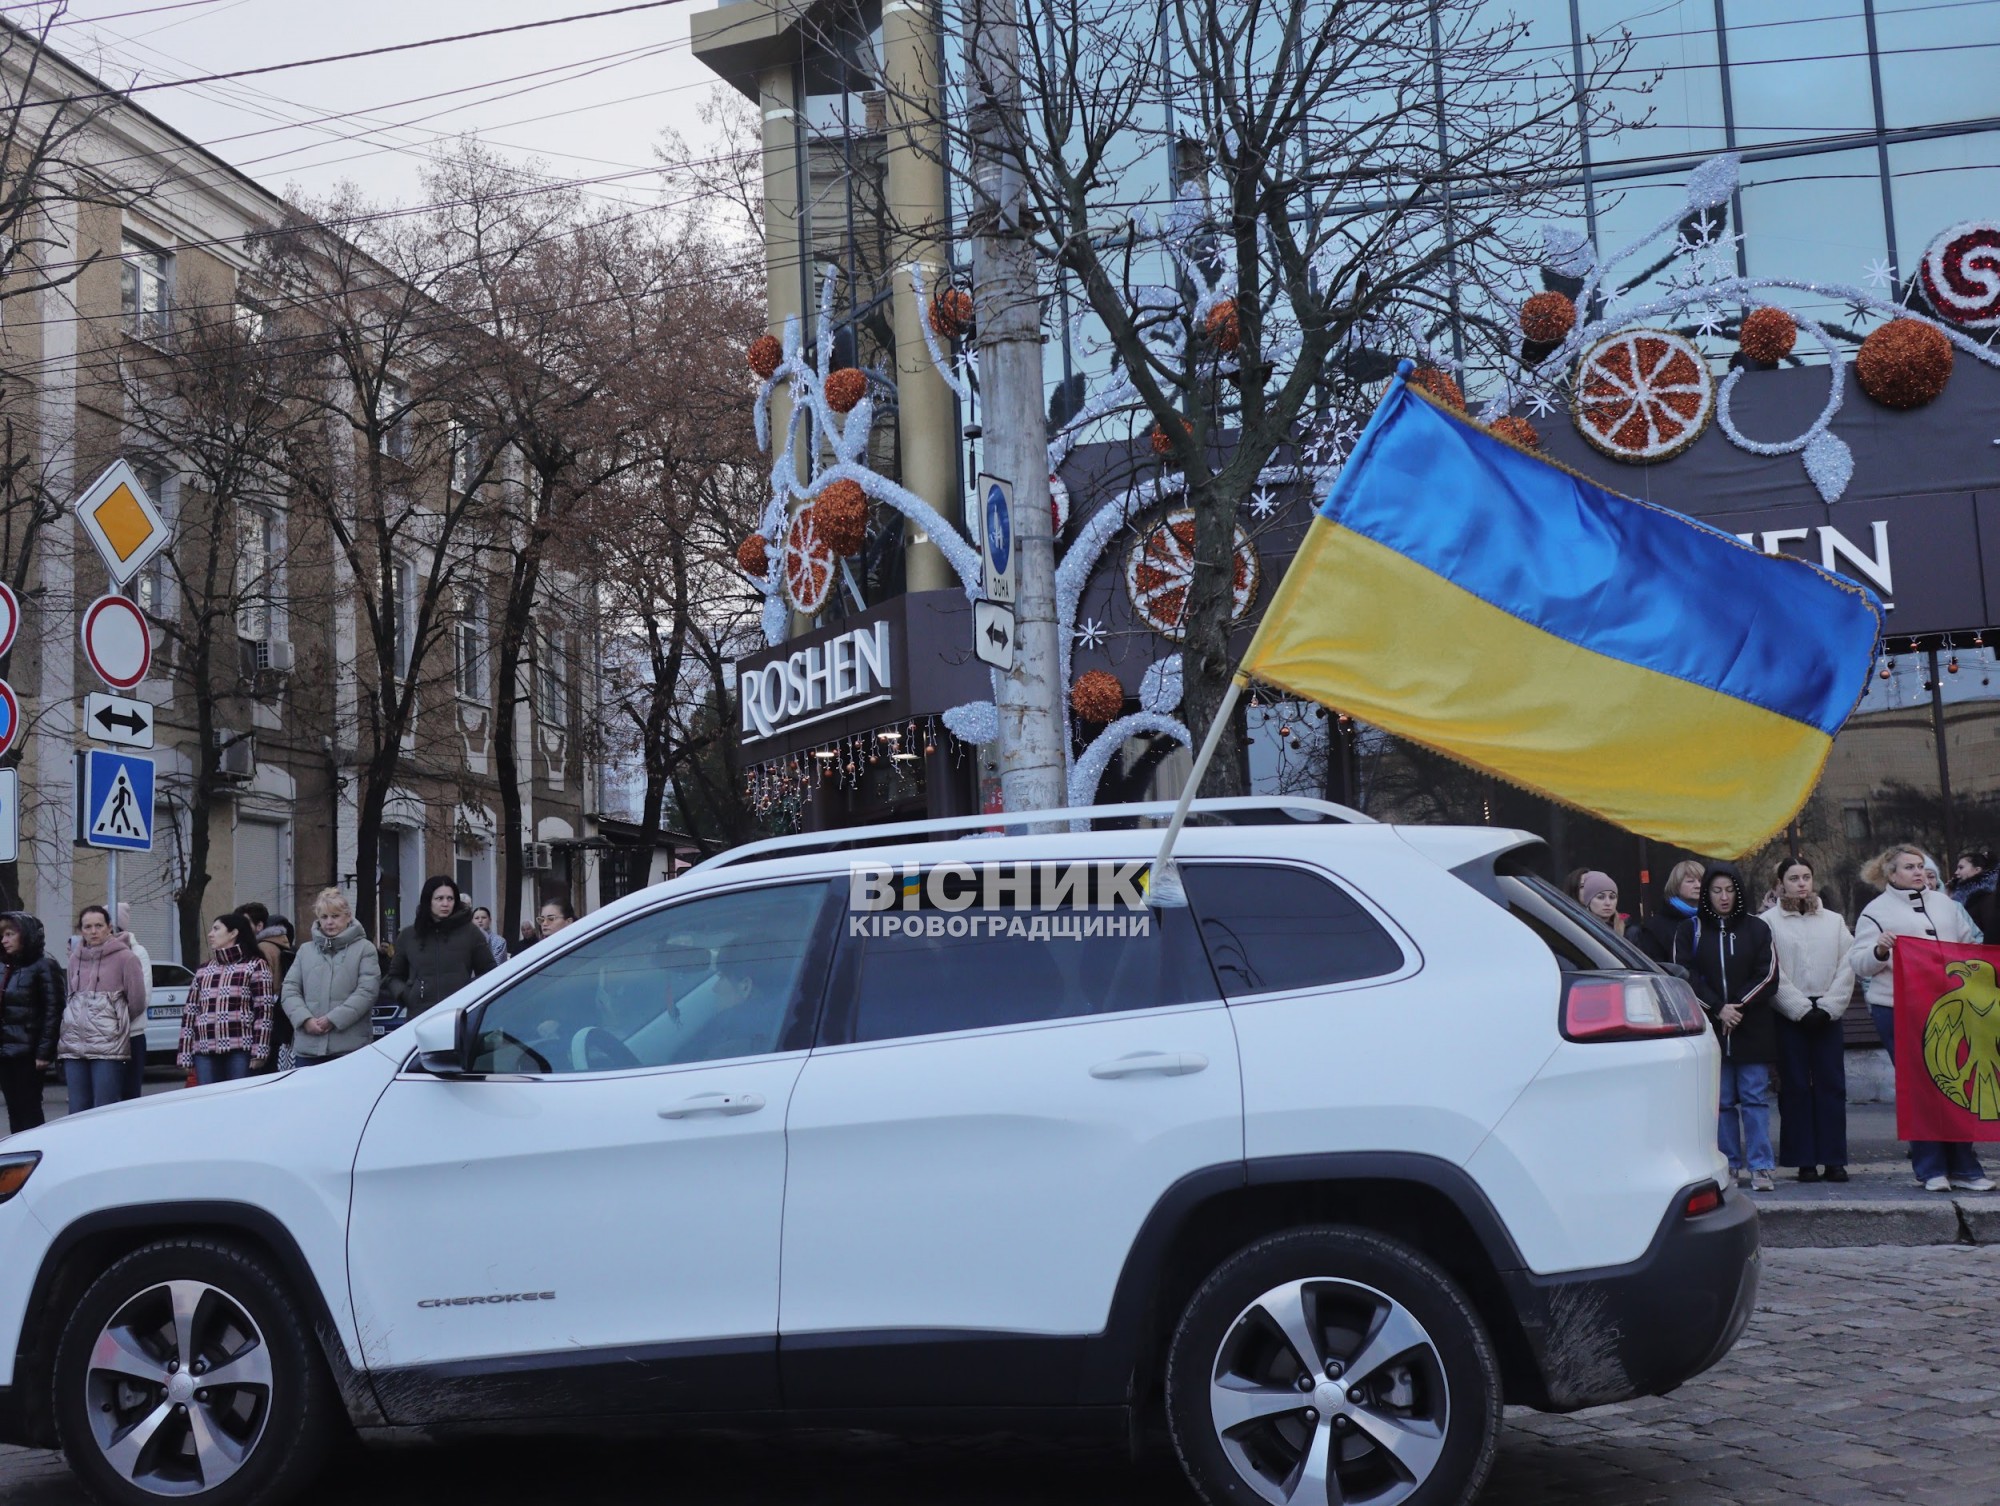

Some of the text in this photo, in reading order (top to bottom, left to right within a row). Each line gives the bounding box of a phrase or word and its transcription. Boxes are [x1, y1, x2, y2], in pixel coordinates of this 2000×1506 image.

[993, 577, 1009, 598] ЗОНА
[741, 620, 891, 738] ROSHEN
[417, 1291, 556, 1308] CHEROKEE
